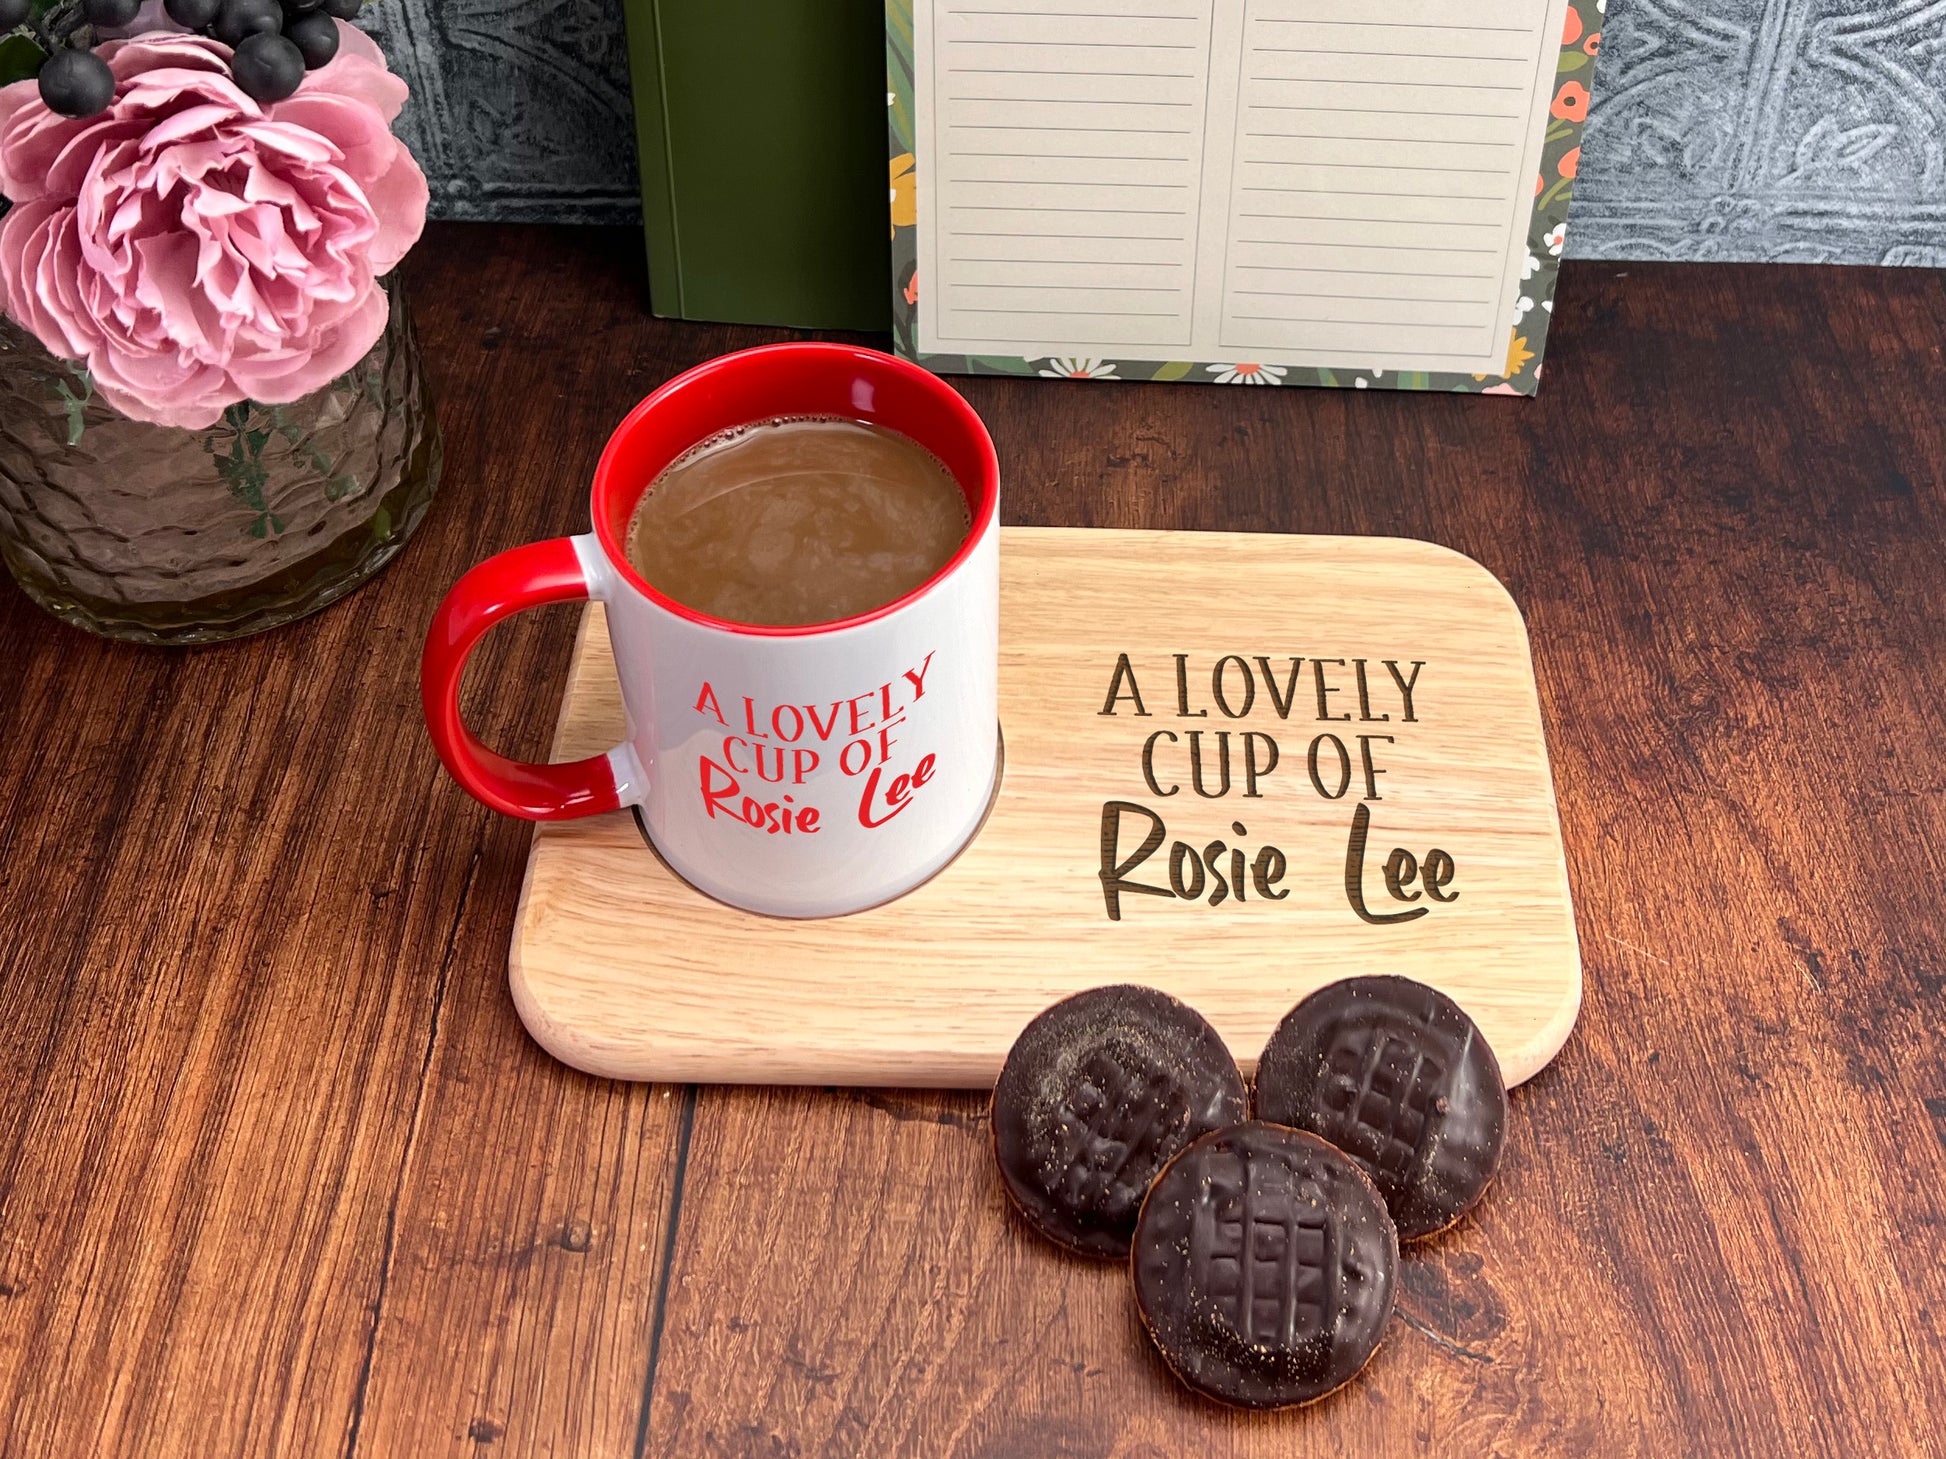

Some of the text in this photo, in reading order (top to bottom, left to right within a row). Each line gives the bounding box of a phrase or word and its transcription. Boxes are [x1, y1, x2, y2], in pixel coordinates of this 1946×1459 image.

[693, 650, 936, 742] A LOVELY
[1097, 653, 1426, 723] A LOVELY
[722, 716, 906, 784] CUP OF
[1141, 730, 1395, 800] CUP OF
[699, 753, 936, 834] Rosie Lee
[1098, 800, 1460, 925] Rosie Lee
